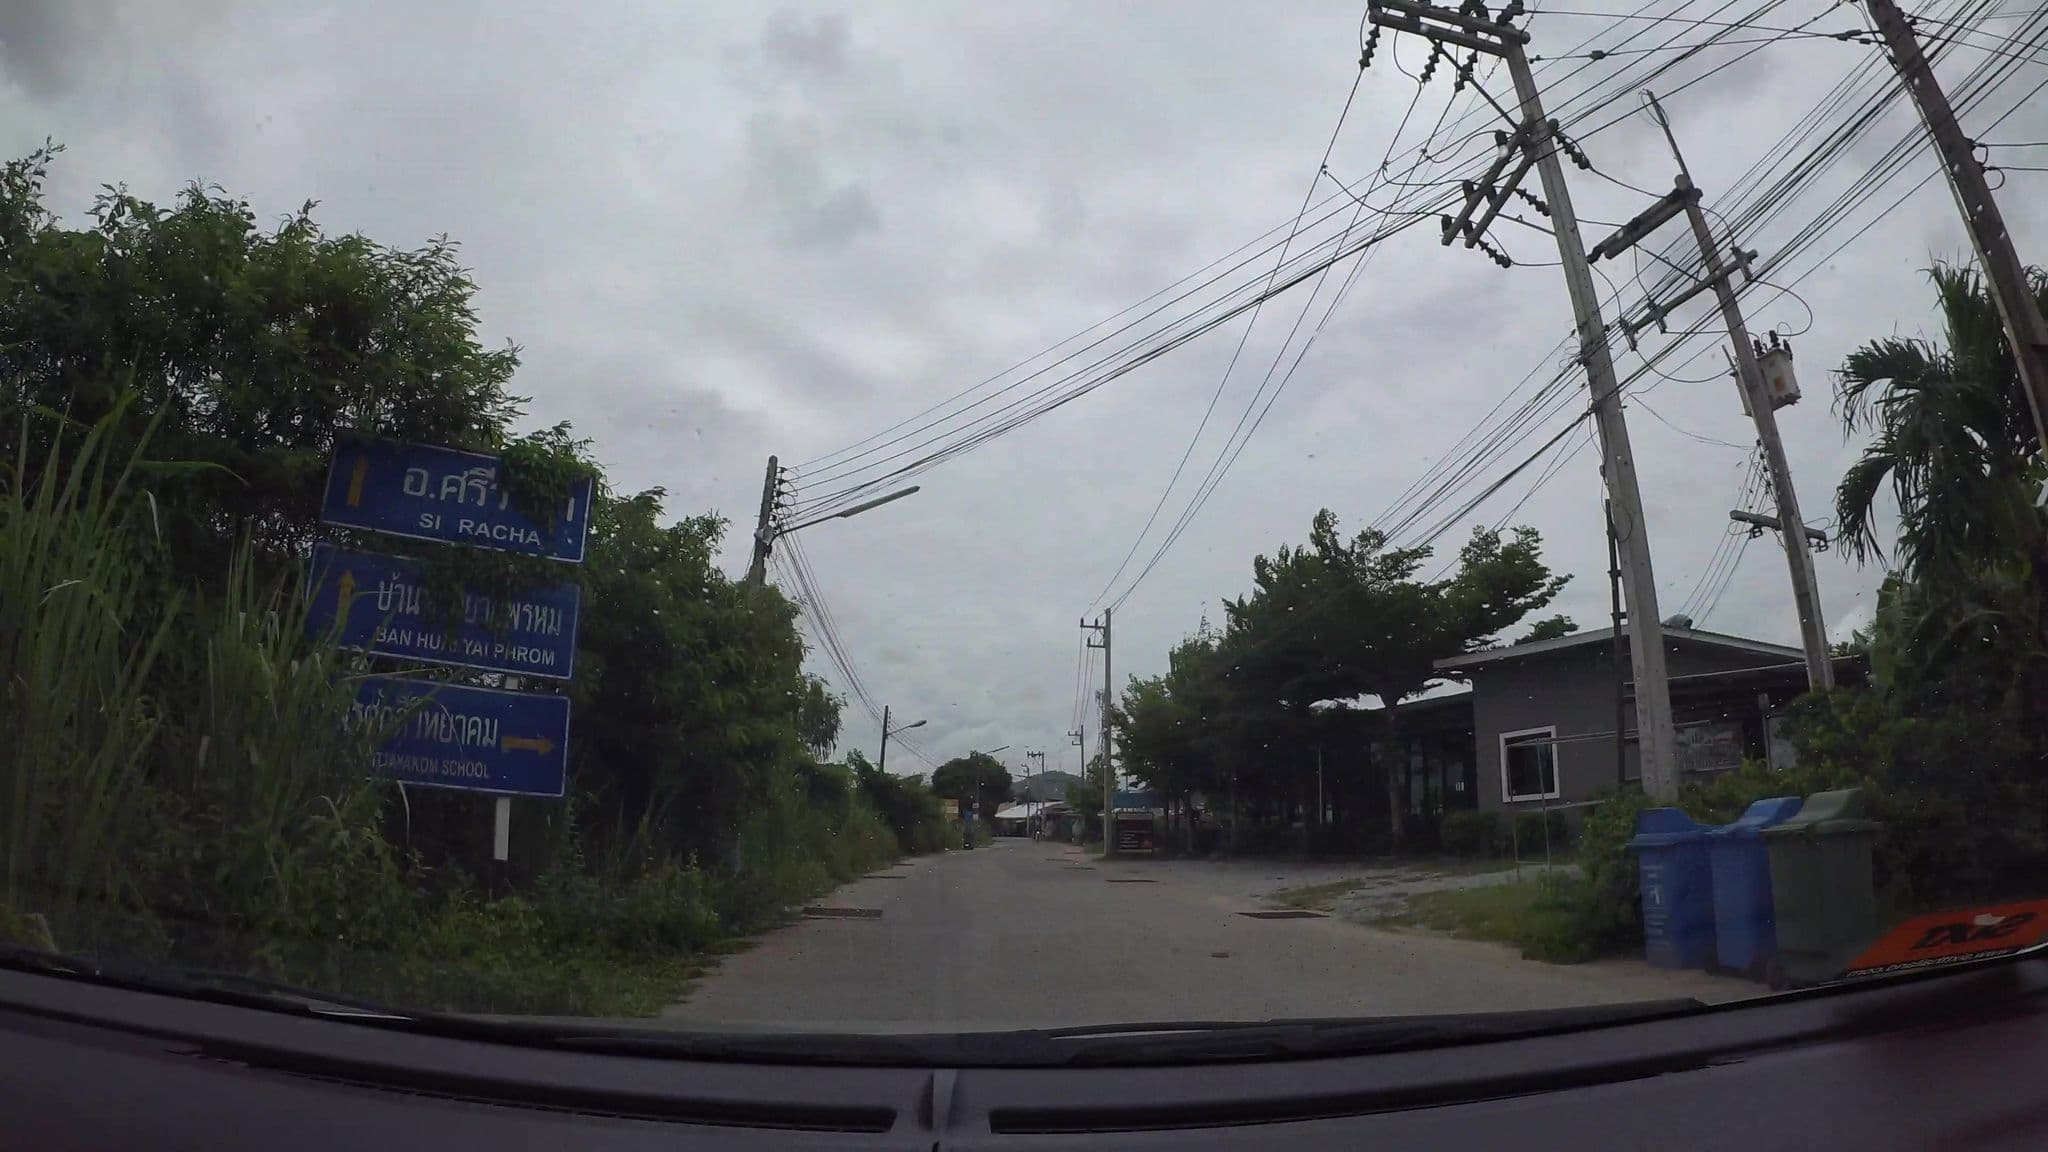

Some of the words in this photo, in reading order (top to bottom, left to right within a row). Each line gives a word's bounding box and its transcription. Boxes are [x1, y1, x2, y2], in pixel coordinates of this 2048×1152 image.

[419, 512, 442, 531] SI
[458, 518, 541, 547] RACHA
[376, 626, 411, 647] BAN
[464, 638, 489, 657] YAI
[494, 643, 555, 666] PHROM
[441, 759, 489, 779] SCHOOL
